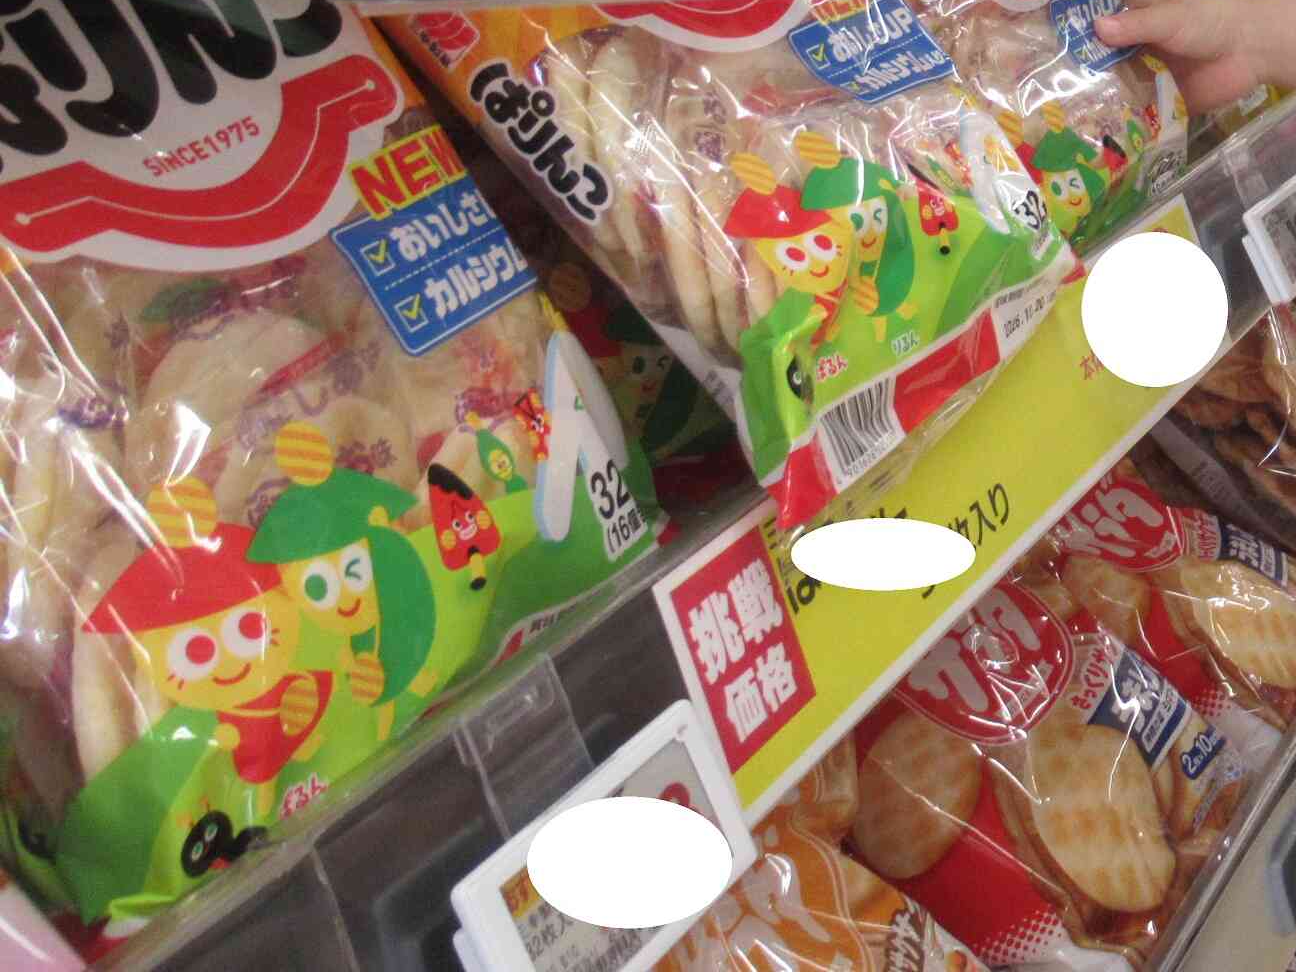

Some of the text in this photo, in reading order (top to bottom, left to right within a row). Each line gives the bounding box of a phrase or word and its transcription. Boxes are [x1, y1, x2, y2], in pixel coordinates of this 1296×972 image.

[470, 62, 610, 222] ぱりんこ
[588, 449, 631, 521] 32
[724, 644, 798, 743] 価格
